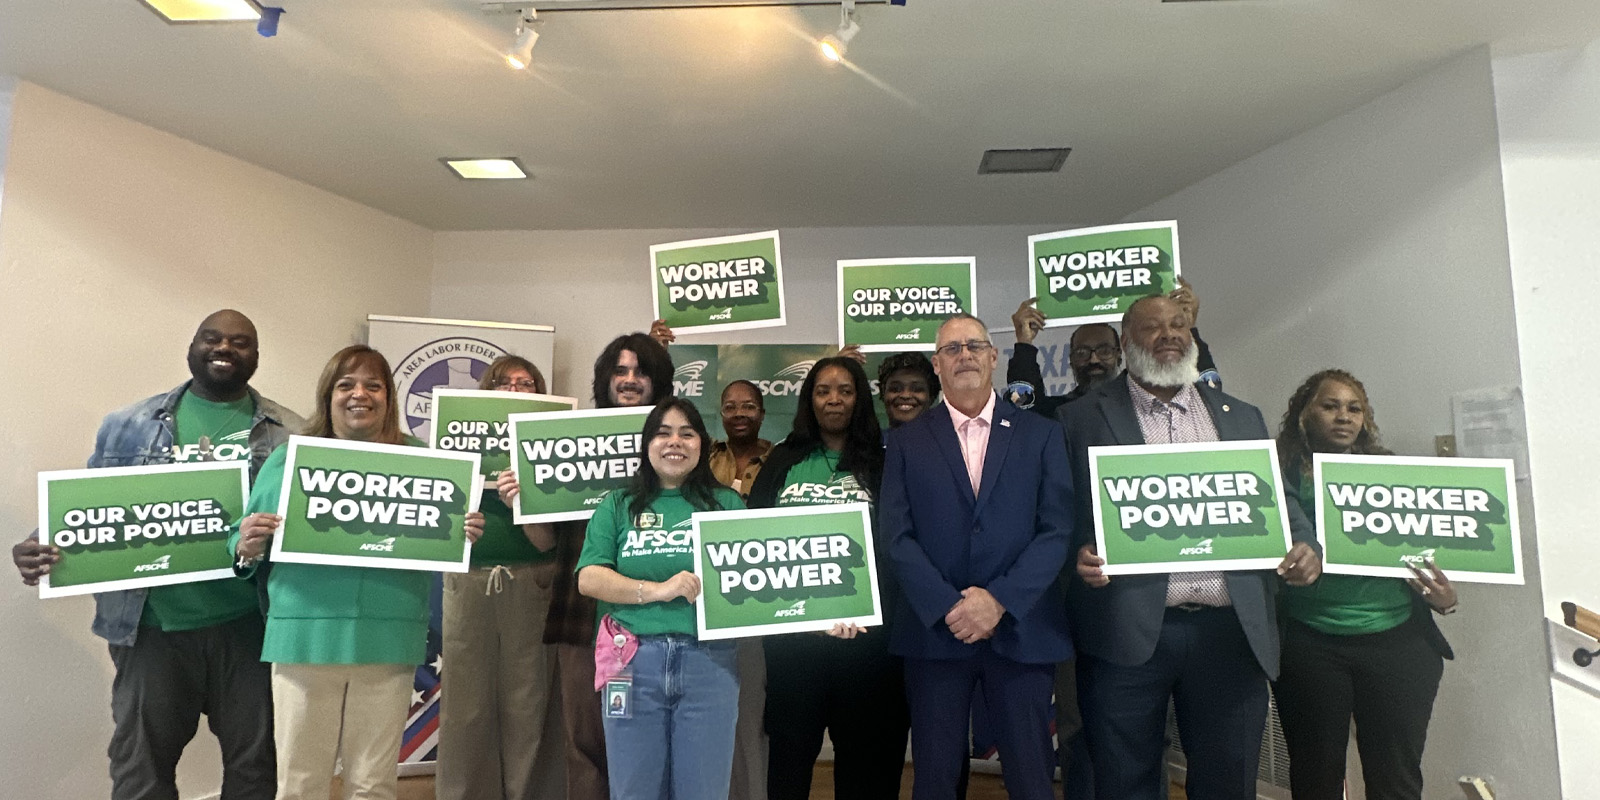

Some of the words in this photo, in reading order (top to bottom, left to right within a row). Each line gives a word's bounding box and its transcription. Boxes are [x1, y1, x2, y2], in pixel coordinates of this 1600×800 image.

[660, 258, 766, 285] WORKER
[1038, 247, 1160, 274] WORKER
[670, 279, 760, 303] POWER
[1049, 268, 1152, 294] POWER
[852, 289, 891, 303] OUR
[895, 287, 956, 301] VOICE.
[1092, 302, 1118, 311] AFSCME
[708, 312, 732, 321] AFSCME
[846, 303, 885, 317] OUR
[889, 301, 963, 316] POWER.
[895, 332, 920, 340] AFSCME
[403, 357, 425, 379] AREA
[425, 343, 461, 359] LABOR
[447, 420, 489, 435] OUR
[439, 436, 482, 450] OUR
[300, 468, 455, 502] WORKER
[1103, 473, 1260, 502] WORKER
[1327, 483, 1490, 513] WORKER
[63, 507, 126, 526] OUR
[131, 500, 221, 520] VOICE.
[306, 496, 441, 528] POWER
[1119, 501, 1254, 530] POWER
[1342, 510, 1479, 539] POWER
[54, 527, 116, 548] OUR
[124, 518, 231, 541] POWER.
[359, 542, 394, 552] AFSCME
[632, 548, 652, 557] Make
[653, 546, 688, 554] America
[706, 536, 852, 567] WORKER
[1178, 545, 1214, 556] AFSCME
[133, 561, 170, 573] AFSCME
[720, 563, 843, 594] POWER
[774, 607, 806, 618] AFSCME
